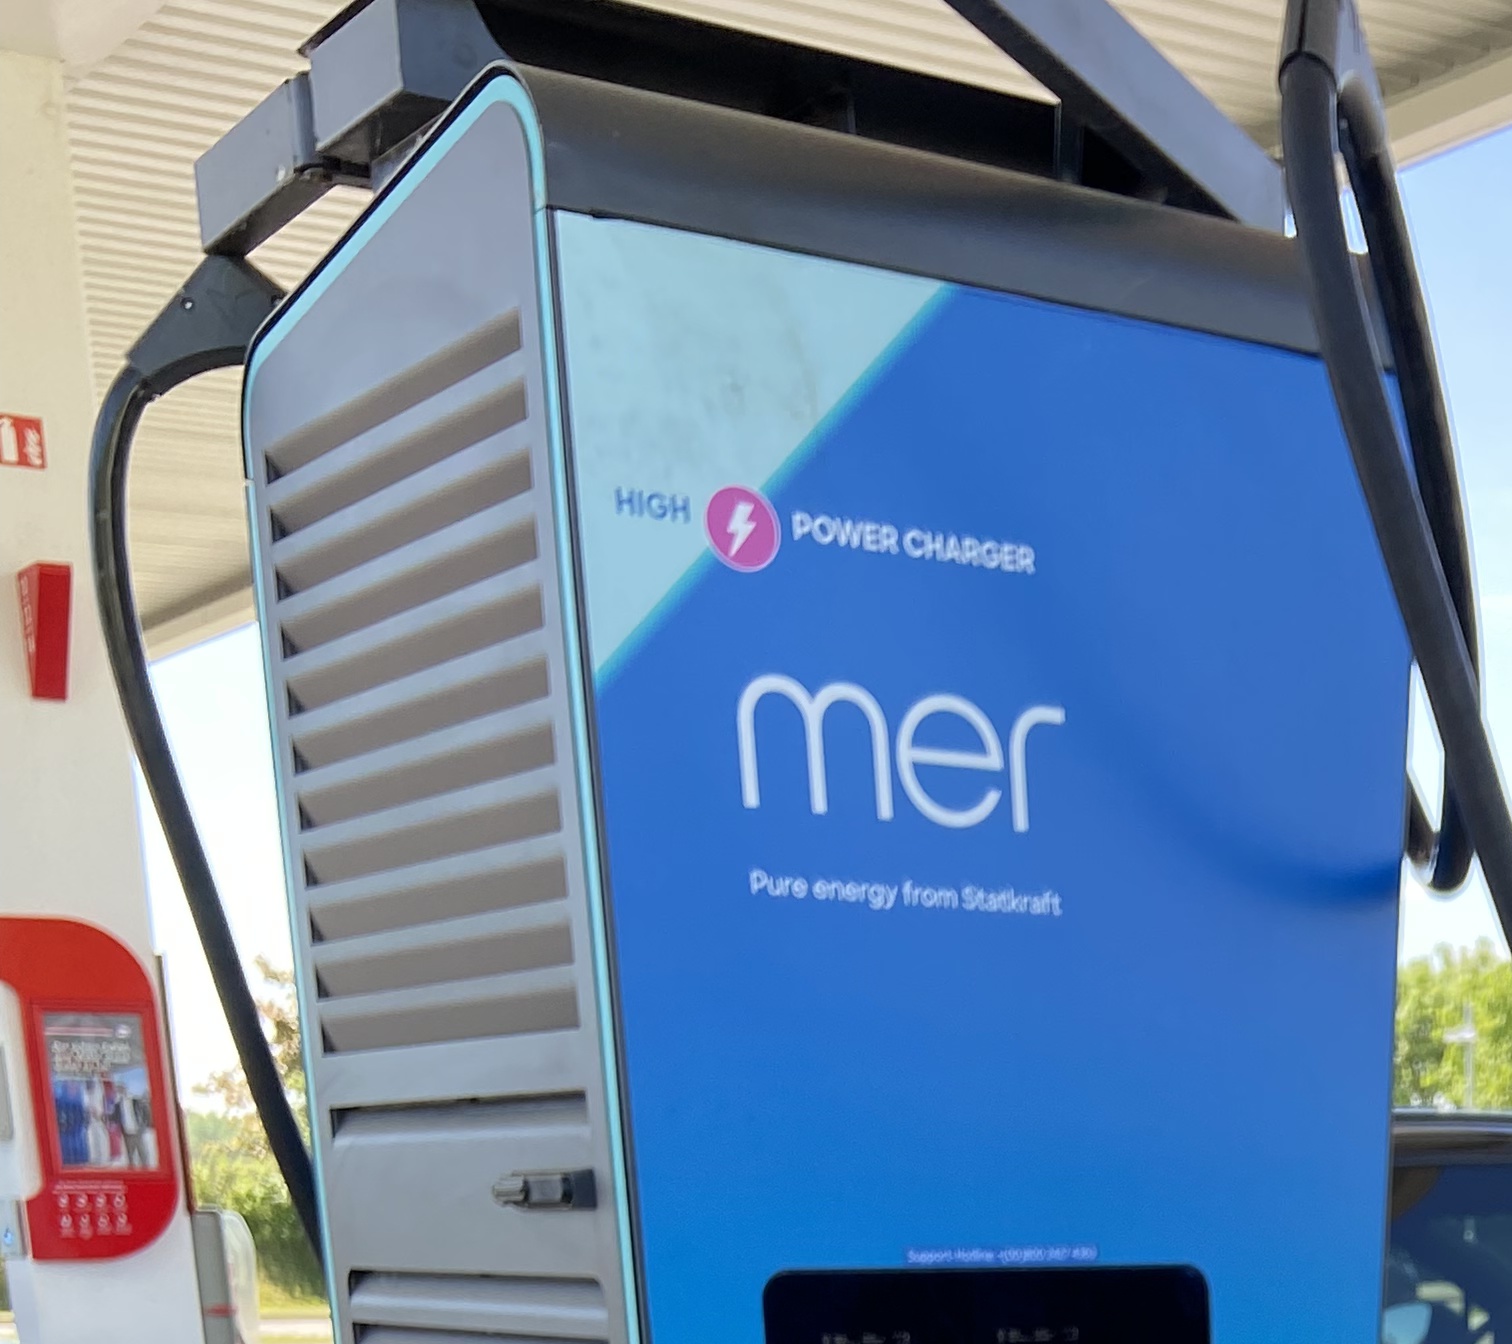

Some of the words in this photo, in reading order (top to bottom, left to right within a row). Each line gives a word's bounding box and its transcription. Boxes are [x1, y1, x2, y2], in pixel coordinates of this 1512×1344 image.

[614, 486, 691, 525] HIGH
[791, 510, 899, 556] POWER
[903, 528, 1037, 575] CHARGER
[737, 673, 1065, 833] mer
[750, 867, 808, 898] Pure
[812, 878, 899, 910] energy
[901, 879, 959, 909] from
[961, 884, 1063, 916] Statkraft
